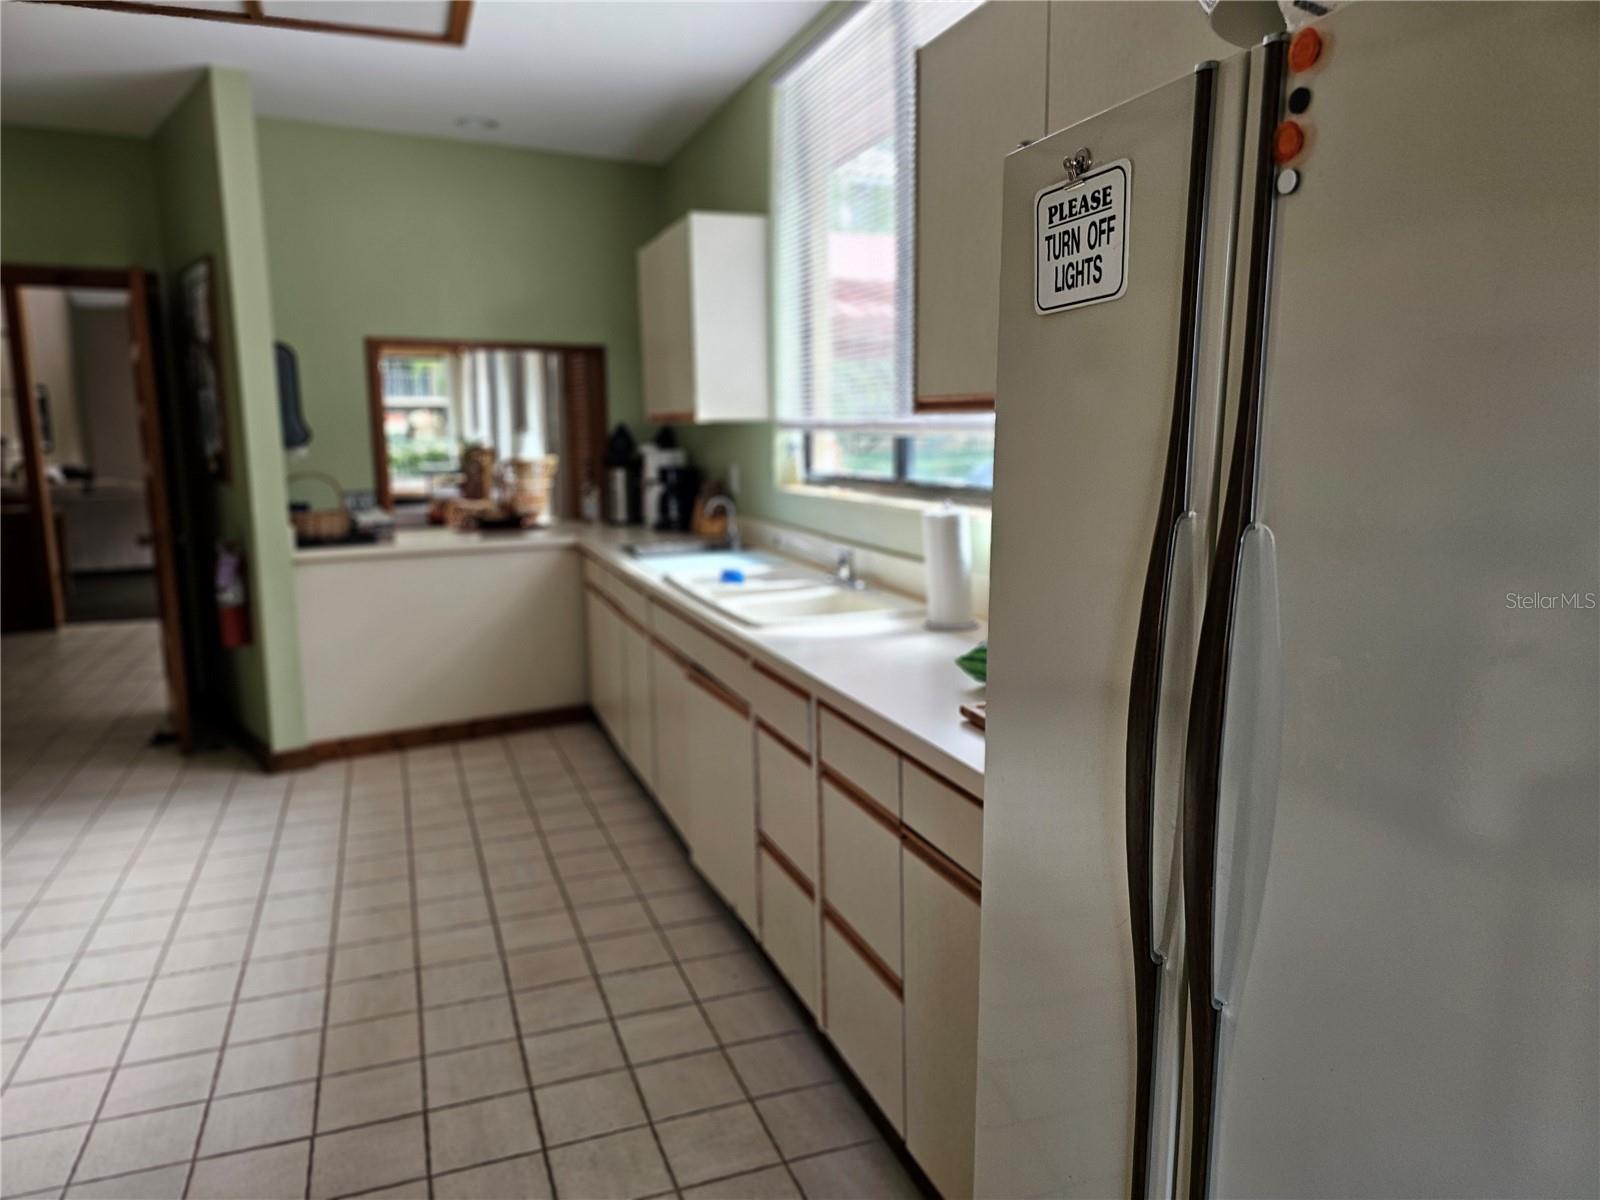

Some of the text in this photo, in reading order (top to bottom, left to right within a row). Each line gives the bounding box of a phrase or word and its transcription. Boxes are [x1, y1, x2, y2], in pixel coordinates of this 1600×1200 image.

[1048, 185, 1112, 225] PLEASE
[1045, 214, 1116, 262] TURN OFF
[1054, 254, 1103, 293] LIGHTS
